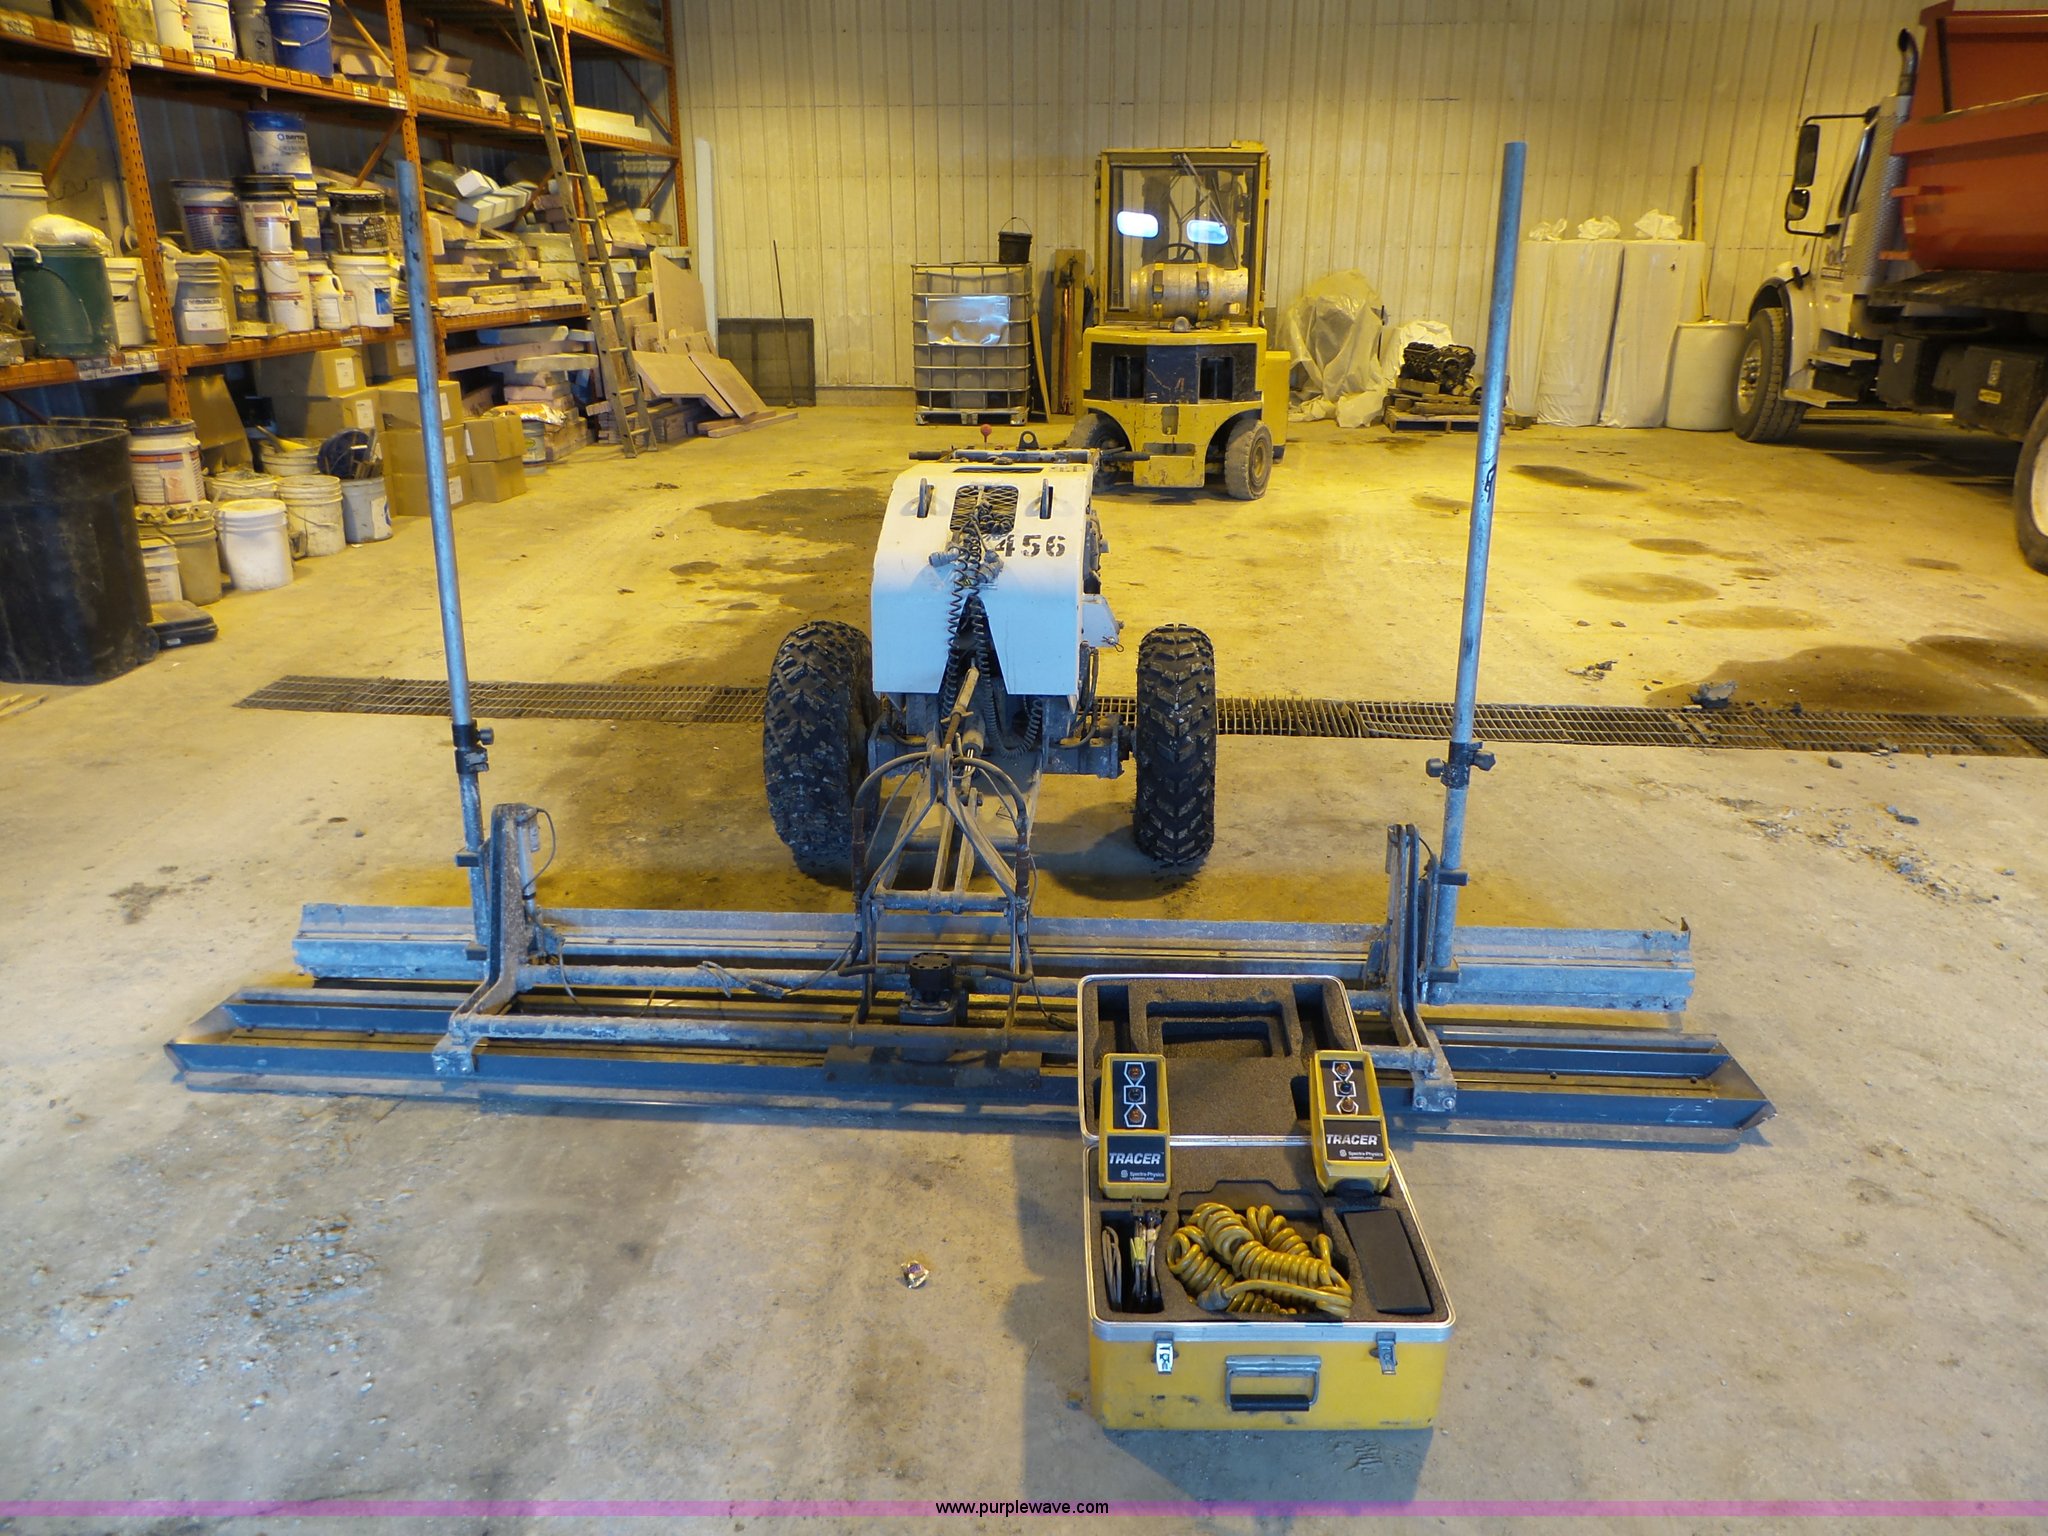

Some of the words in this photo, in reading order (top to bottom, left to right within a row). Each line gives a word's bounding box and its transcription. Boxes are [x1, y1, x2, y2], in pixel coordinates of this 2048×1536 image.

[994, 534, 1066, 557] 456
[1325, 1134, 1378, 1146] TRACER
[1109, 1152, 1161, 1165] TRACER
